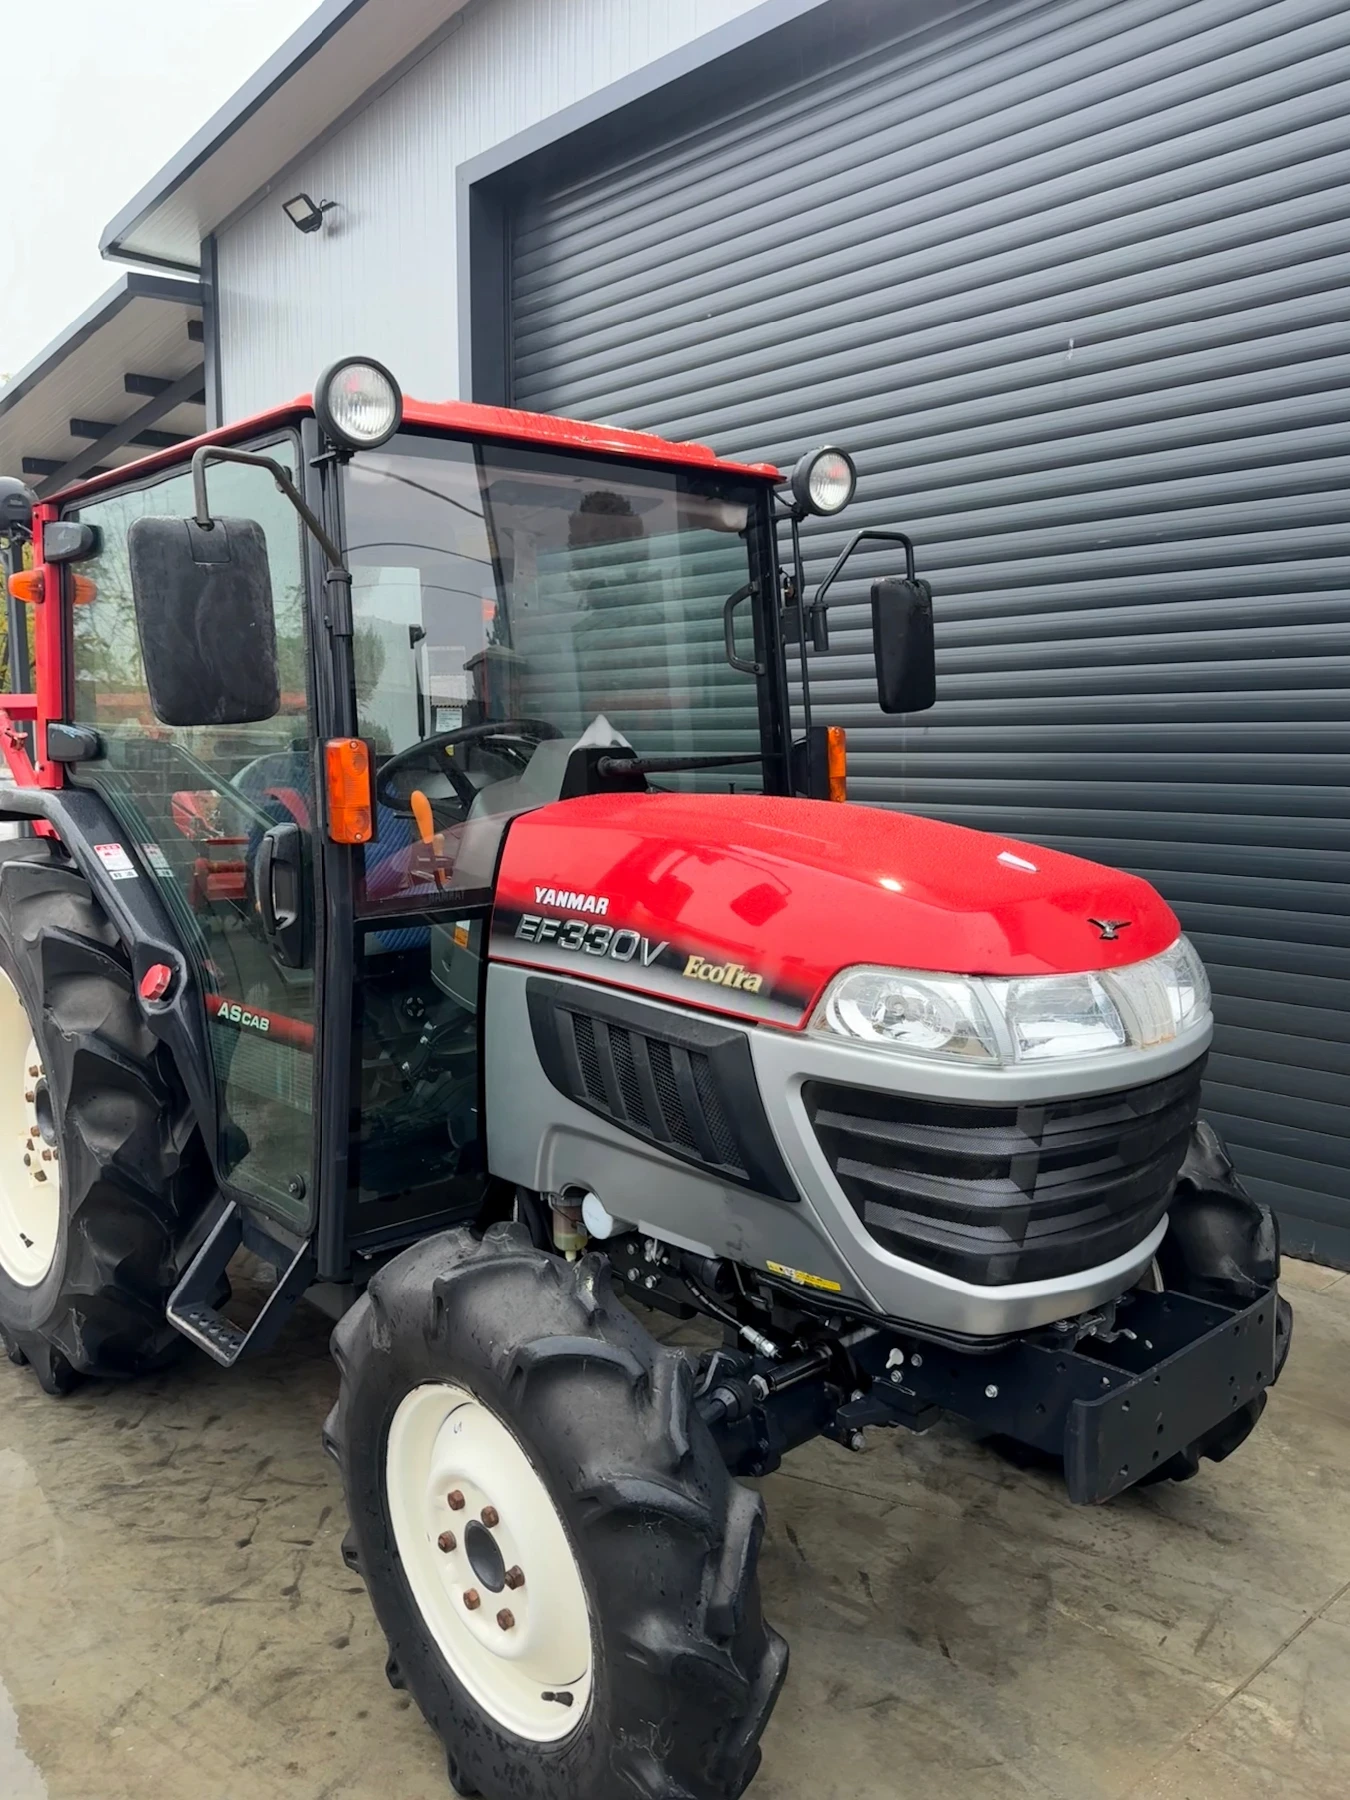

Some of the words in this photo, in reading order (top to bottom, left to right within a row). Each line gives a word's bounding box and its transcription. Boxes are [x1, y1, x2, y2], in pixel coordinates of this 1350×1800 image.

[535, 886, 610, 915] YANMAR
[514, 914, 670, 967] EF330V
[683, 954, 763, 993] EcoTra
